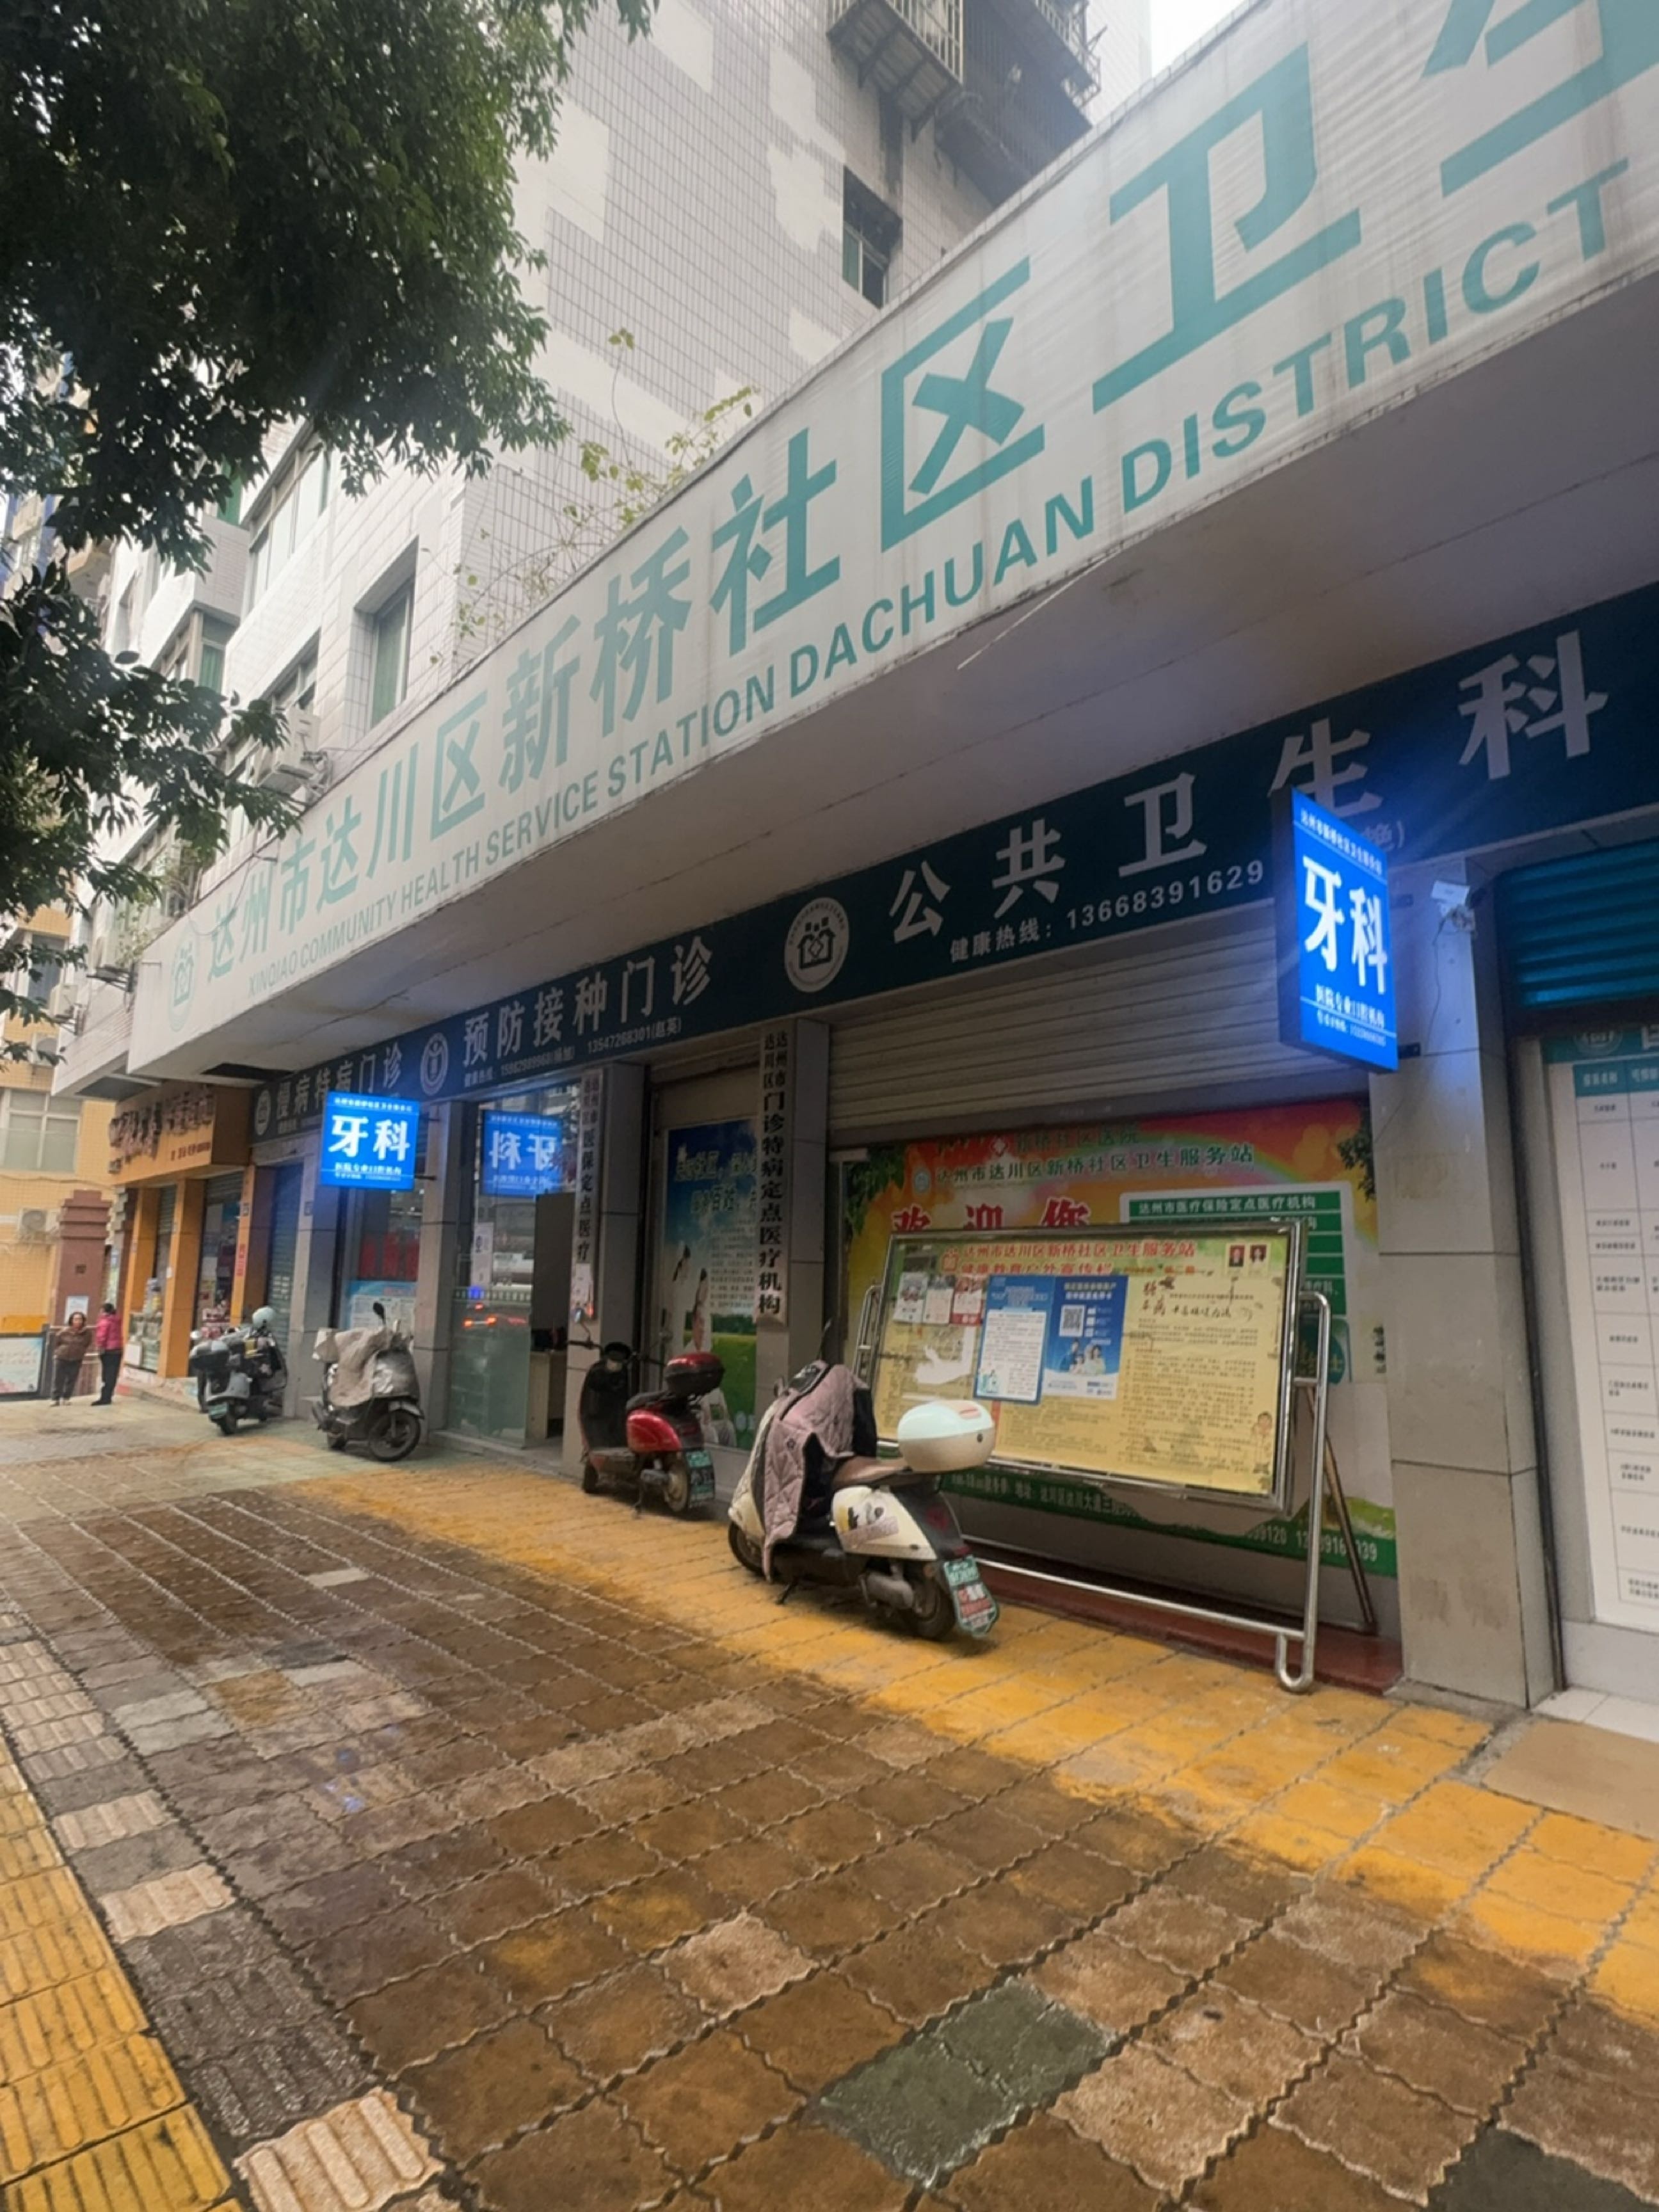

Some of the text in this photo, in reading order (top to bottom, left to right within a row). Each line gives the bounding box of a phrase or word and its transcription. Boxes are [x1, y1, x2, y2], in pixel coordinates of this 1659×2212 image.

[248, 157, 1629, 997] XINQIAO COMMUNITY HEALTH SERVICE STATION DACHUAN DISTRICT
[889, 630, 1609, 943] 公共卫生科
[1067, 860, 1265, 930] 13668391629
[1302, 855, 1388, 995] 牙科
[462, 935, 712, 1068] 预防接种门诊
[276, 1041, 403, 1119] 慢病特病门诊
[327, 1114, 410, 1162] 牙科
[758, 1092, 785, 1314] 门诊特病定点医疗机构
[936, 1142, 1254, 1182] 达州市达川区新桥社区卫生服务站
